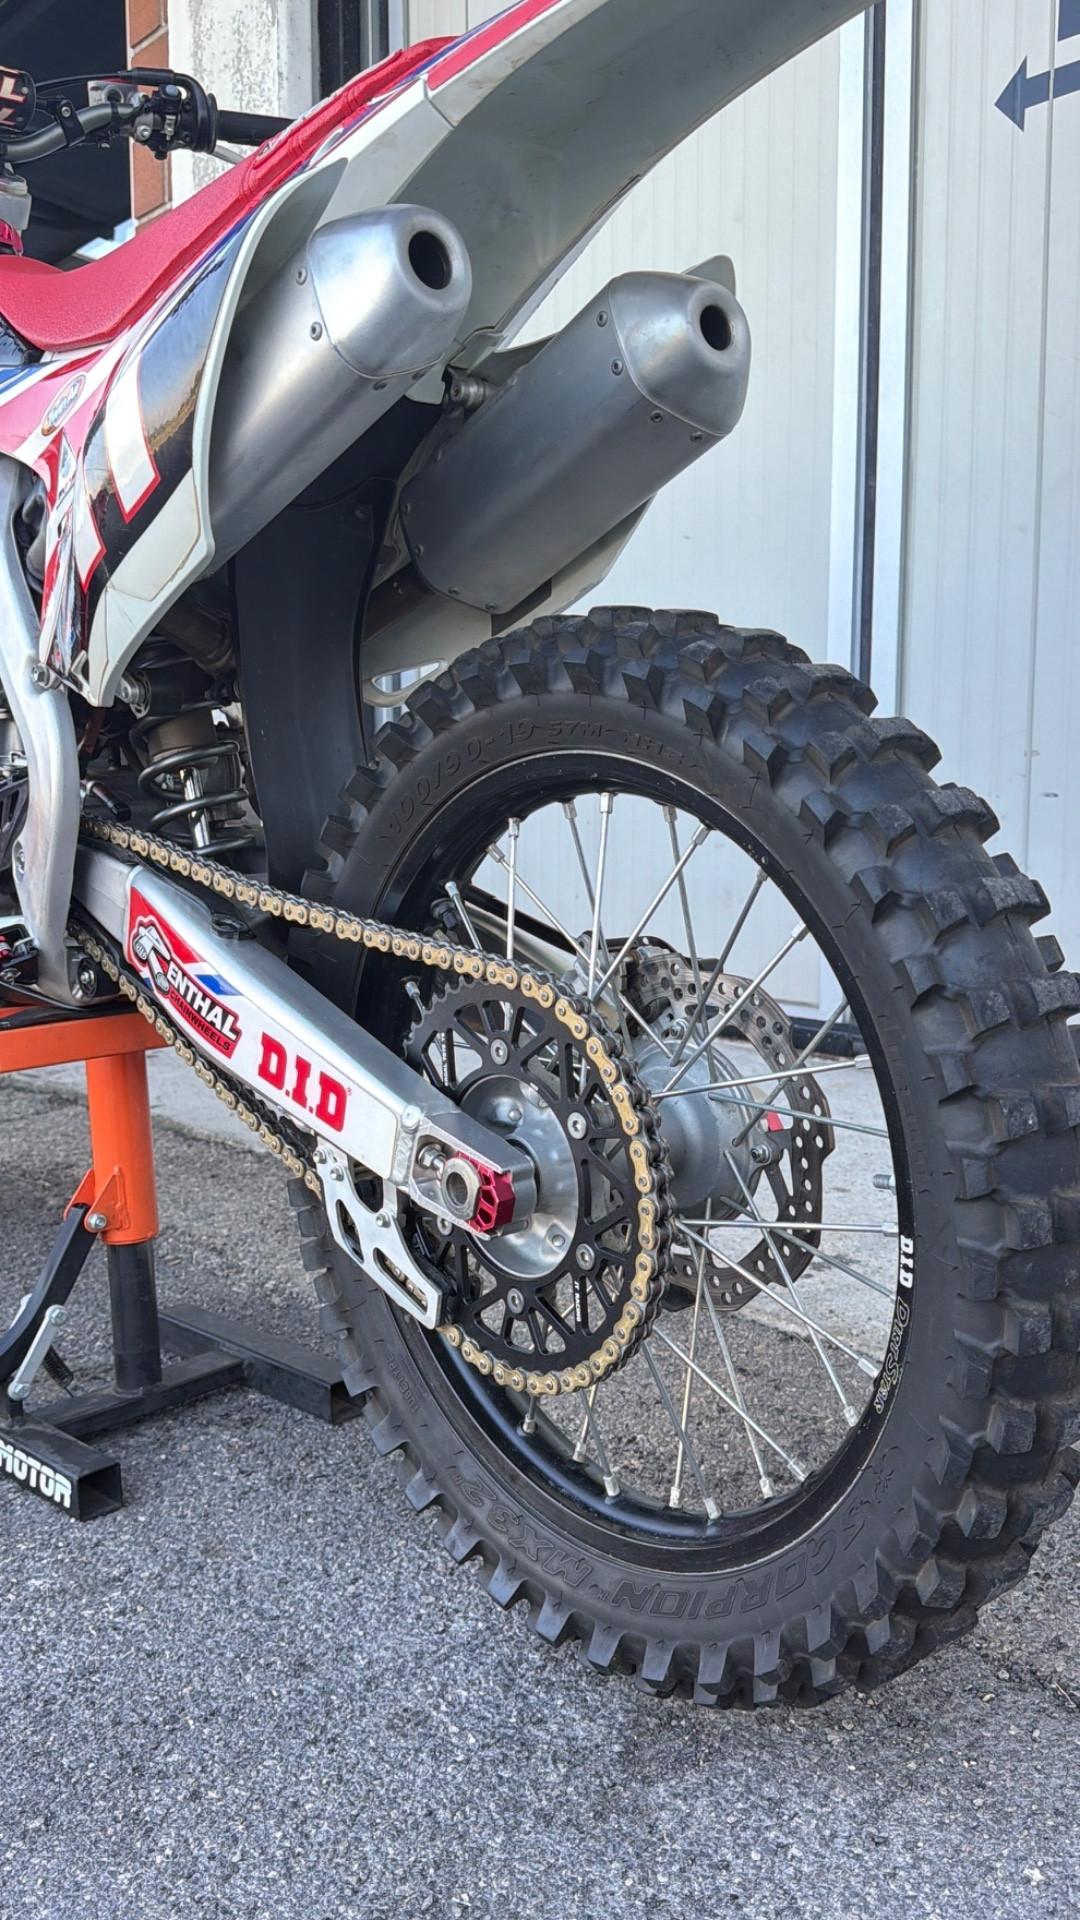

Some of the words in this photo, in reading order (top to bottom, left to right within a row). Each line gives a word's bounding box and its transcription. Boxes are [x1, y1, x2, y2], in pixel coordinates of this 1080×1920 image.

[169, 989, 232, 1052] CHAINWHEELS
[257, 1031, 348, 1133] D.I.D
[610, 1499, 870, 1620] SCORPION
